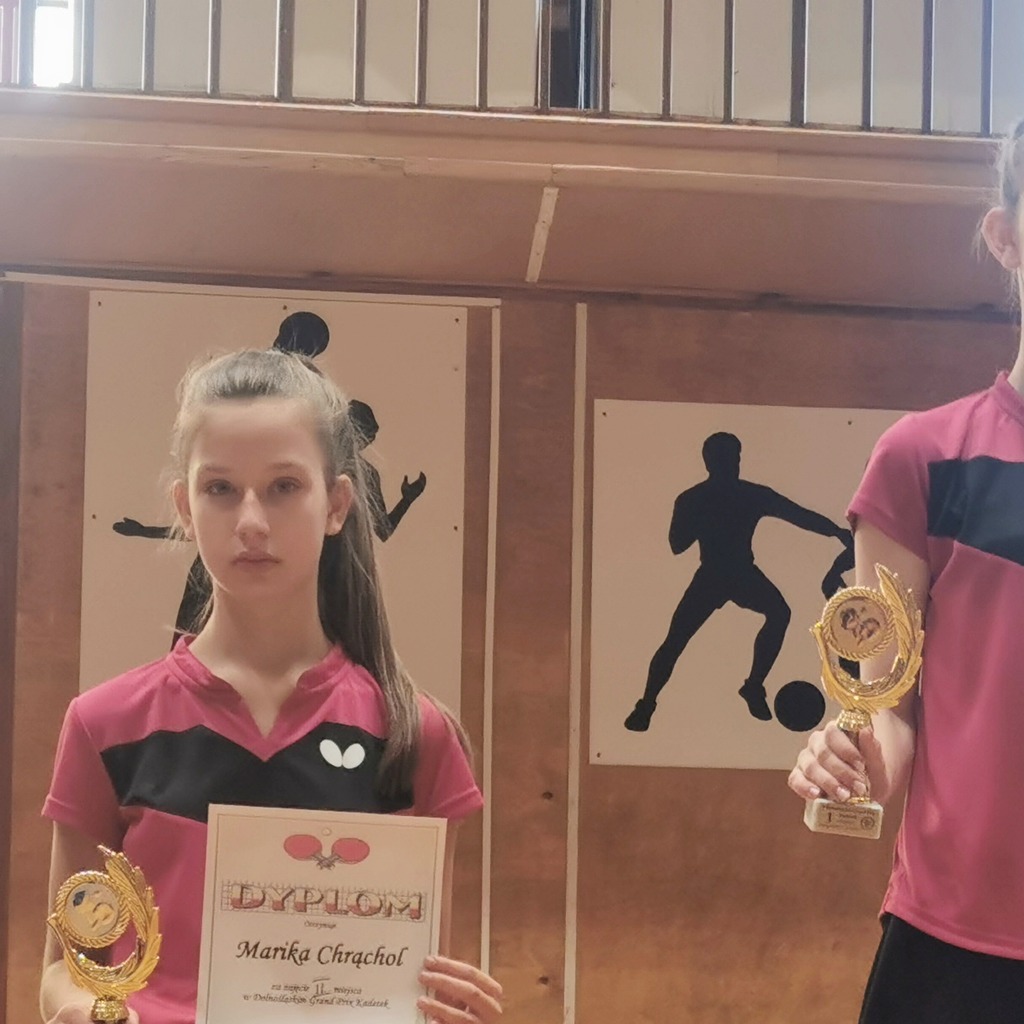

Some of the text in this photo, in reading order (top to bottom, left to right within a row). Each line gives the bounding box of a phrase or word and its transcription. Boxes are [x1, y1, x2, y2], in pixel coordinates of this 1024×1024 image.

[229, 883, 423, 921] DYPLOM
[235, 940, 409, 969] Marika Chrąchol
